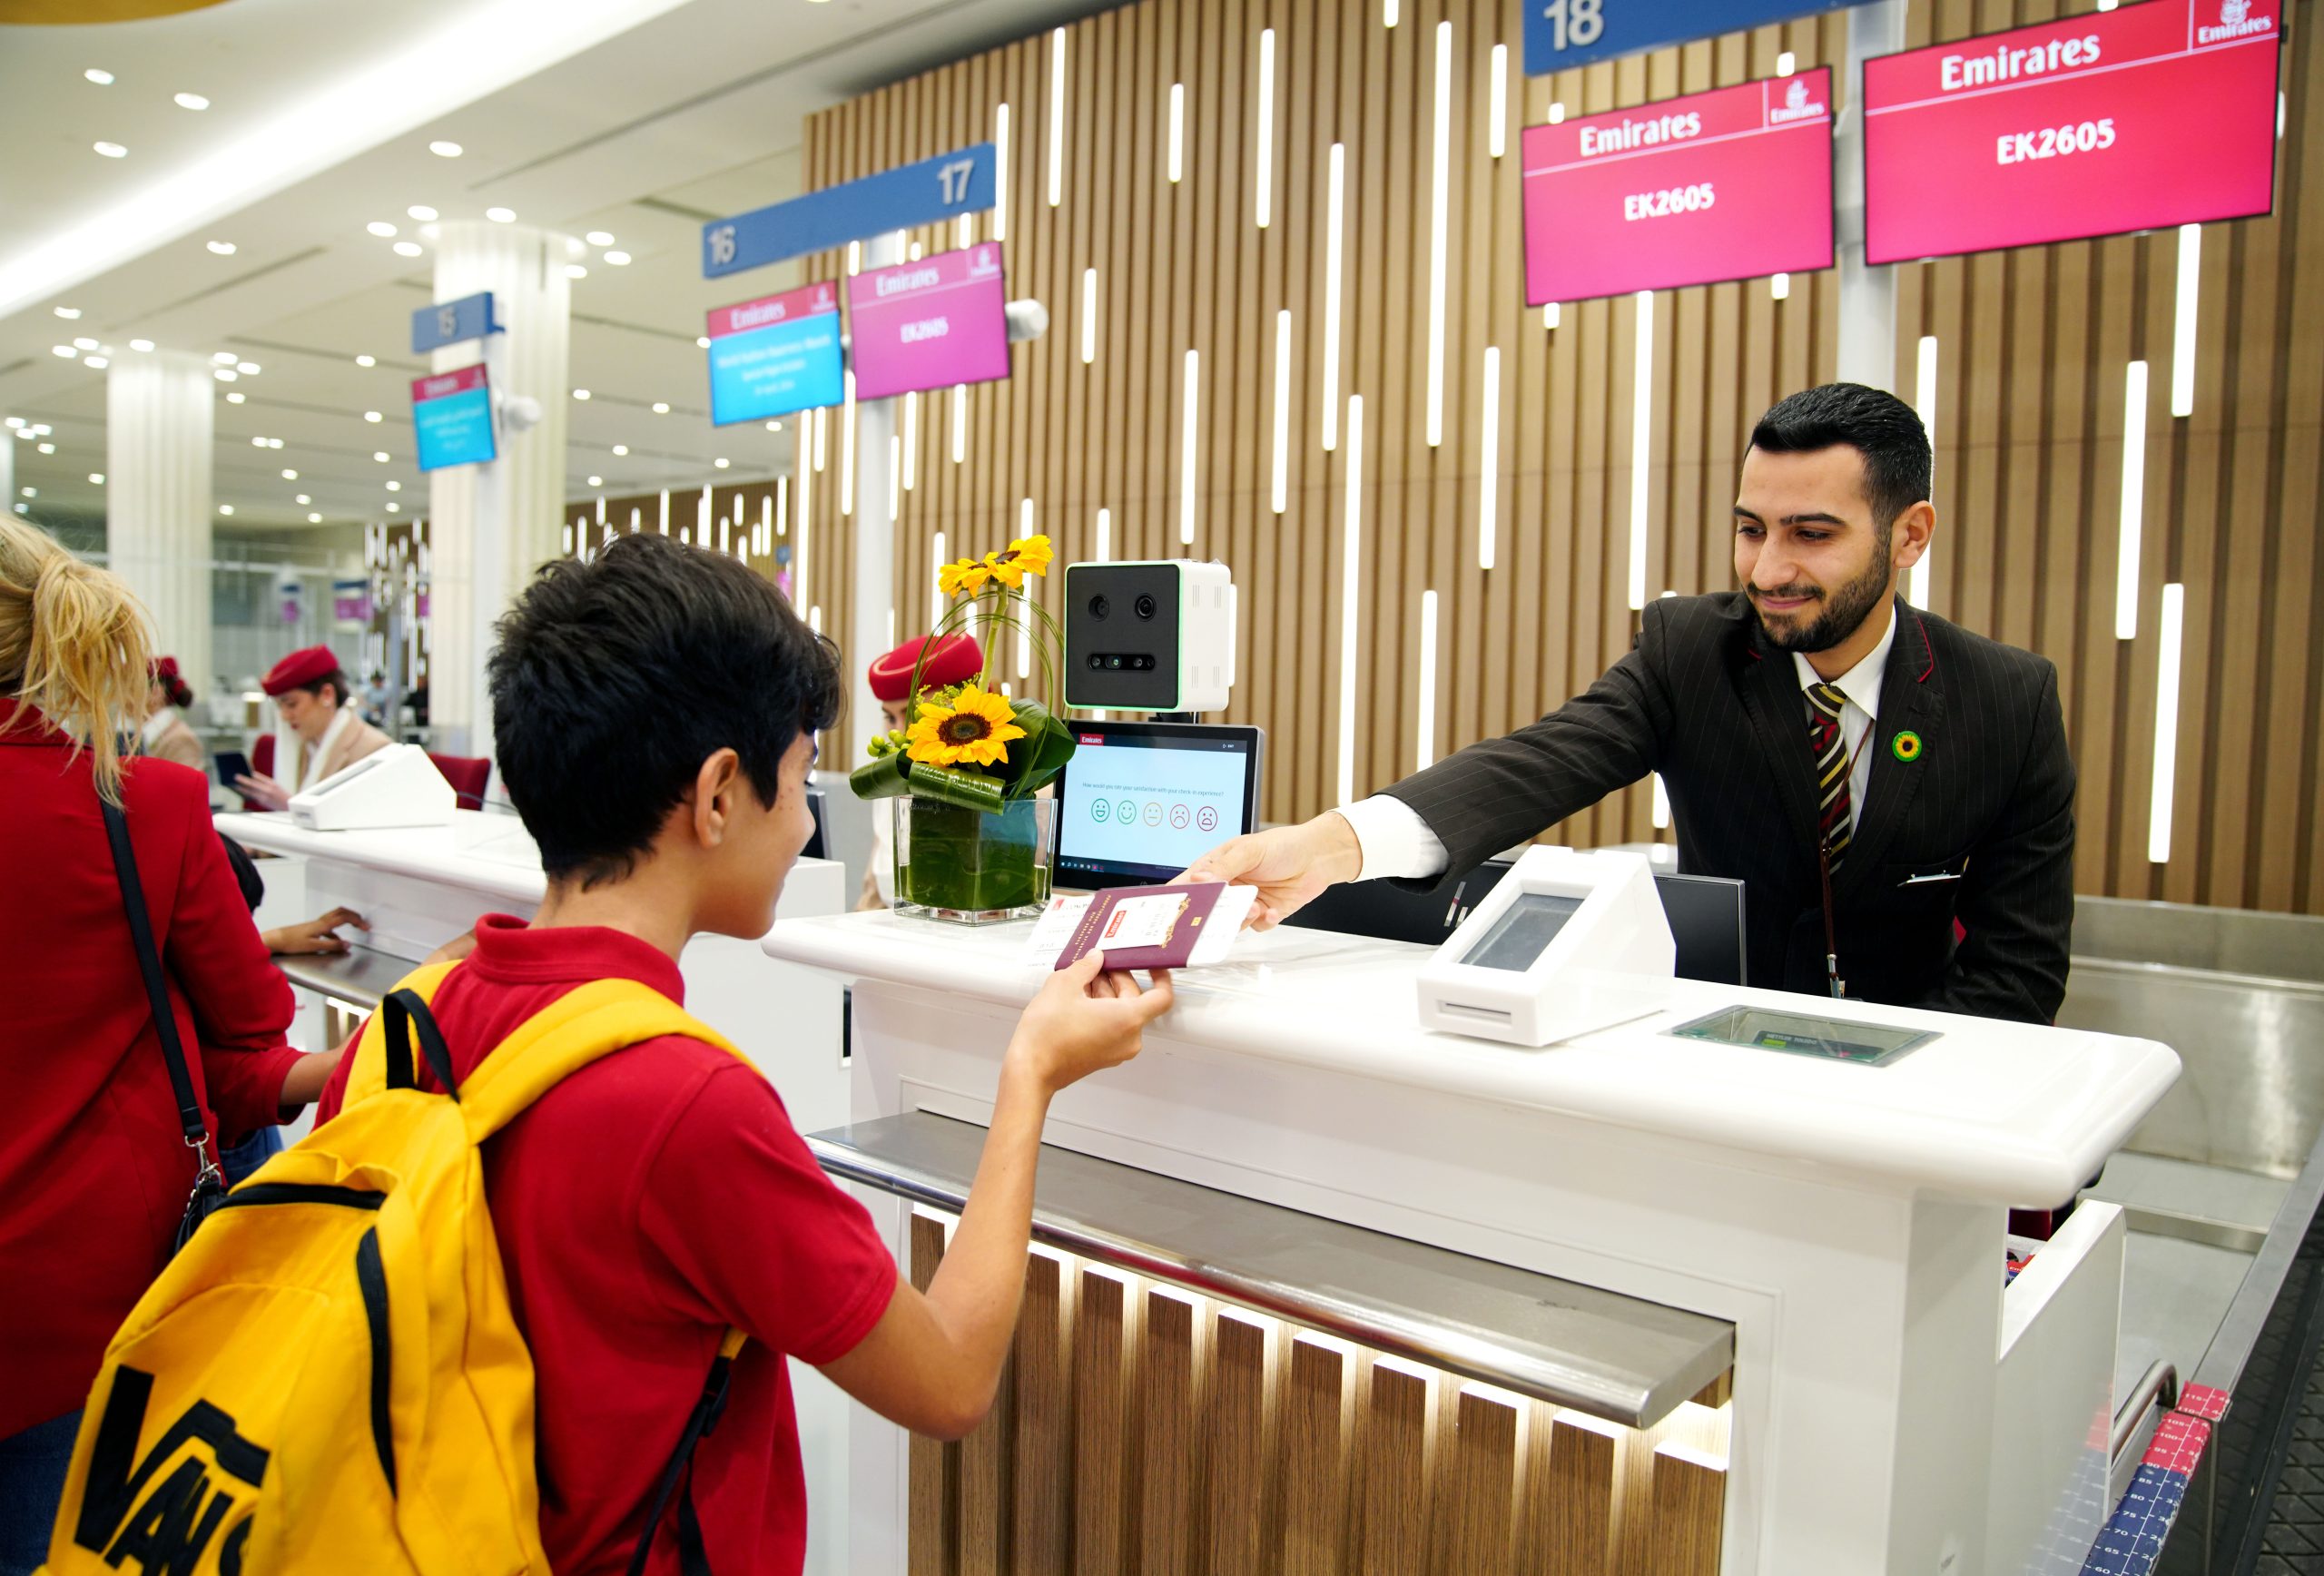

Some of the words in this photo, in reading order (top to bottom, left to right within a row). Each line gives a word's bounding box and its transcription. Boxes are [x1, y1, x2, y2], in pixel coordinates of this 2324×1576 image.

[1543, 0, 1604, 51] 18
[2198, 15, 2272, 44] Emirates
[1941, 34, 2101, 91] Emirates
[1580, 112, 1701, 157] Emirates
[1996, 118, 2115, 165] EK2605
[937, 158, 974, 204] 17
[1624, 182, 1715, 222] EK2605
[708, 225, 736, 264] 16
[875, 267, 940, 297] Emirates
[2113, 1528, 2129, 1536] 70
[2122, 1510, 2137, 1518] 75
[2094, 1566, 2111, 1574] 60
[2104, 1547, 2120, 1555] 65
